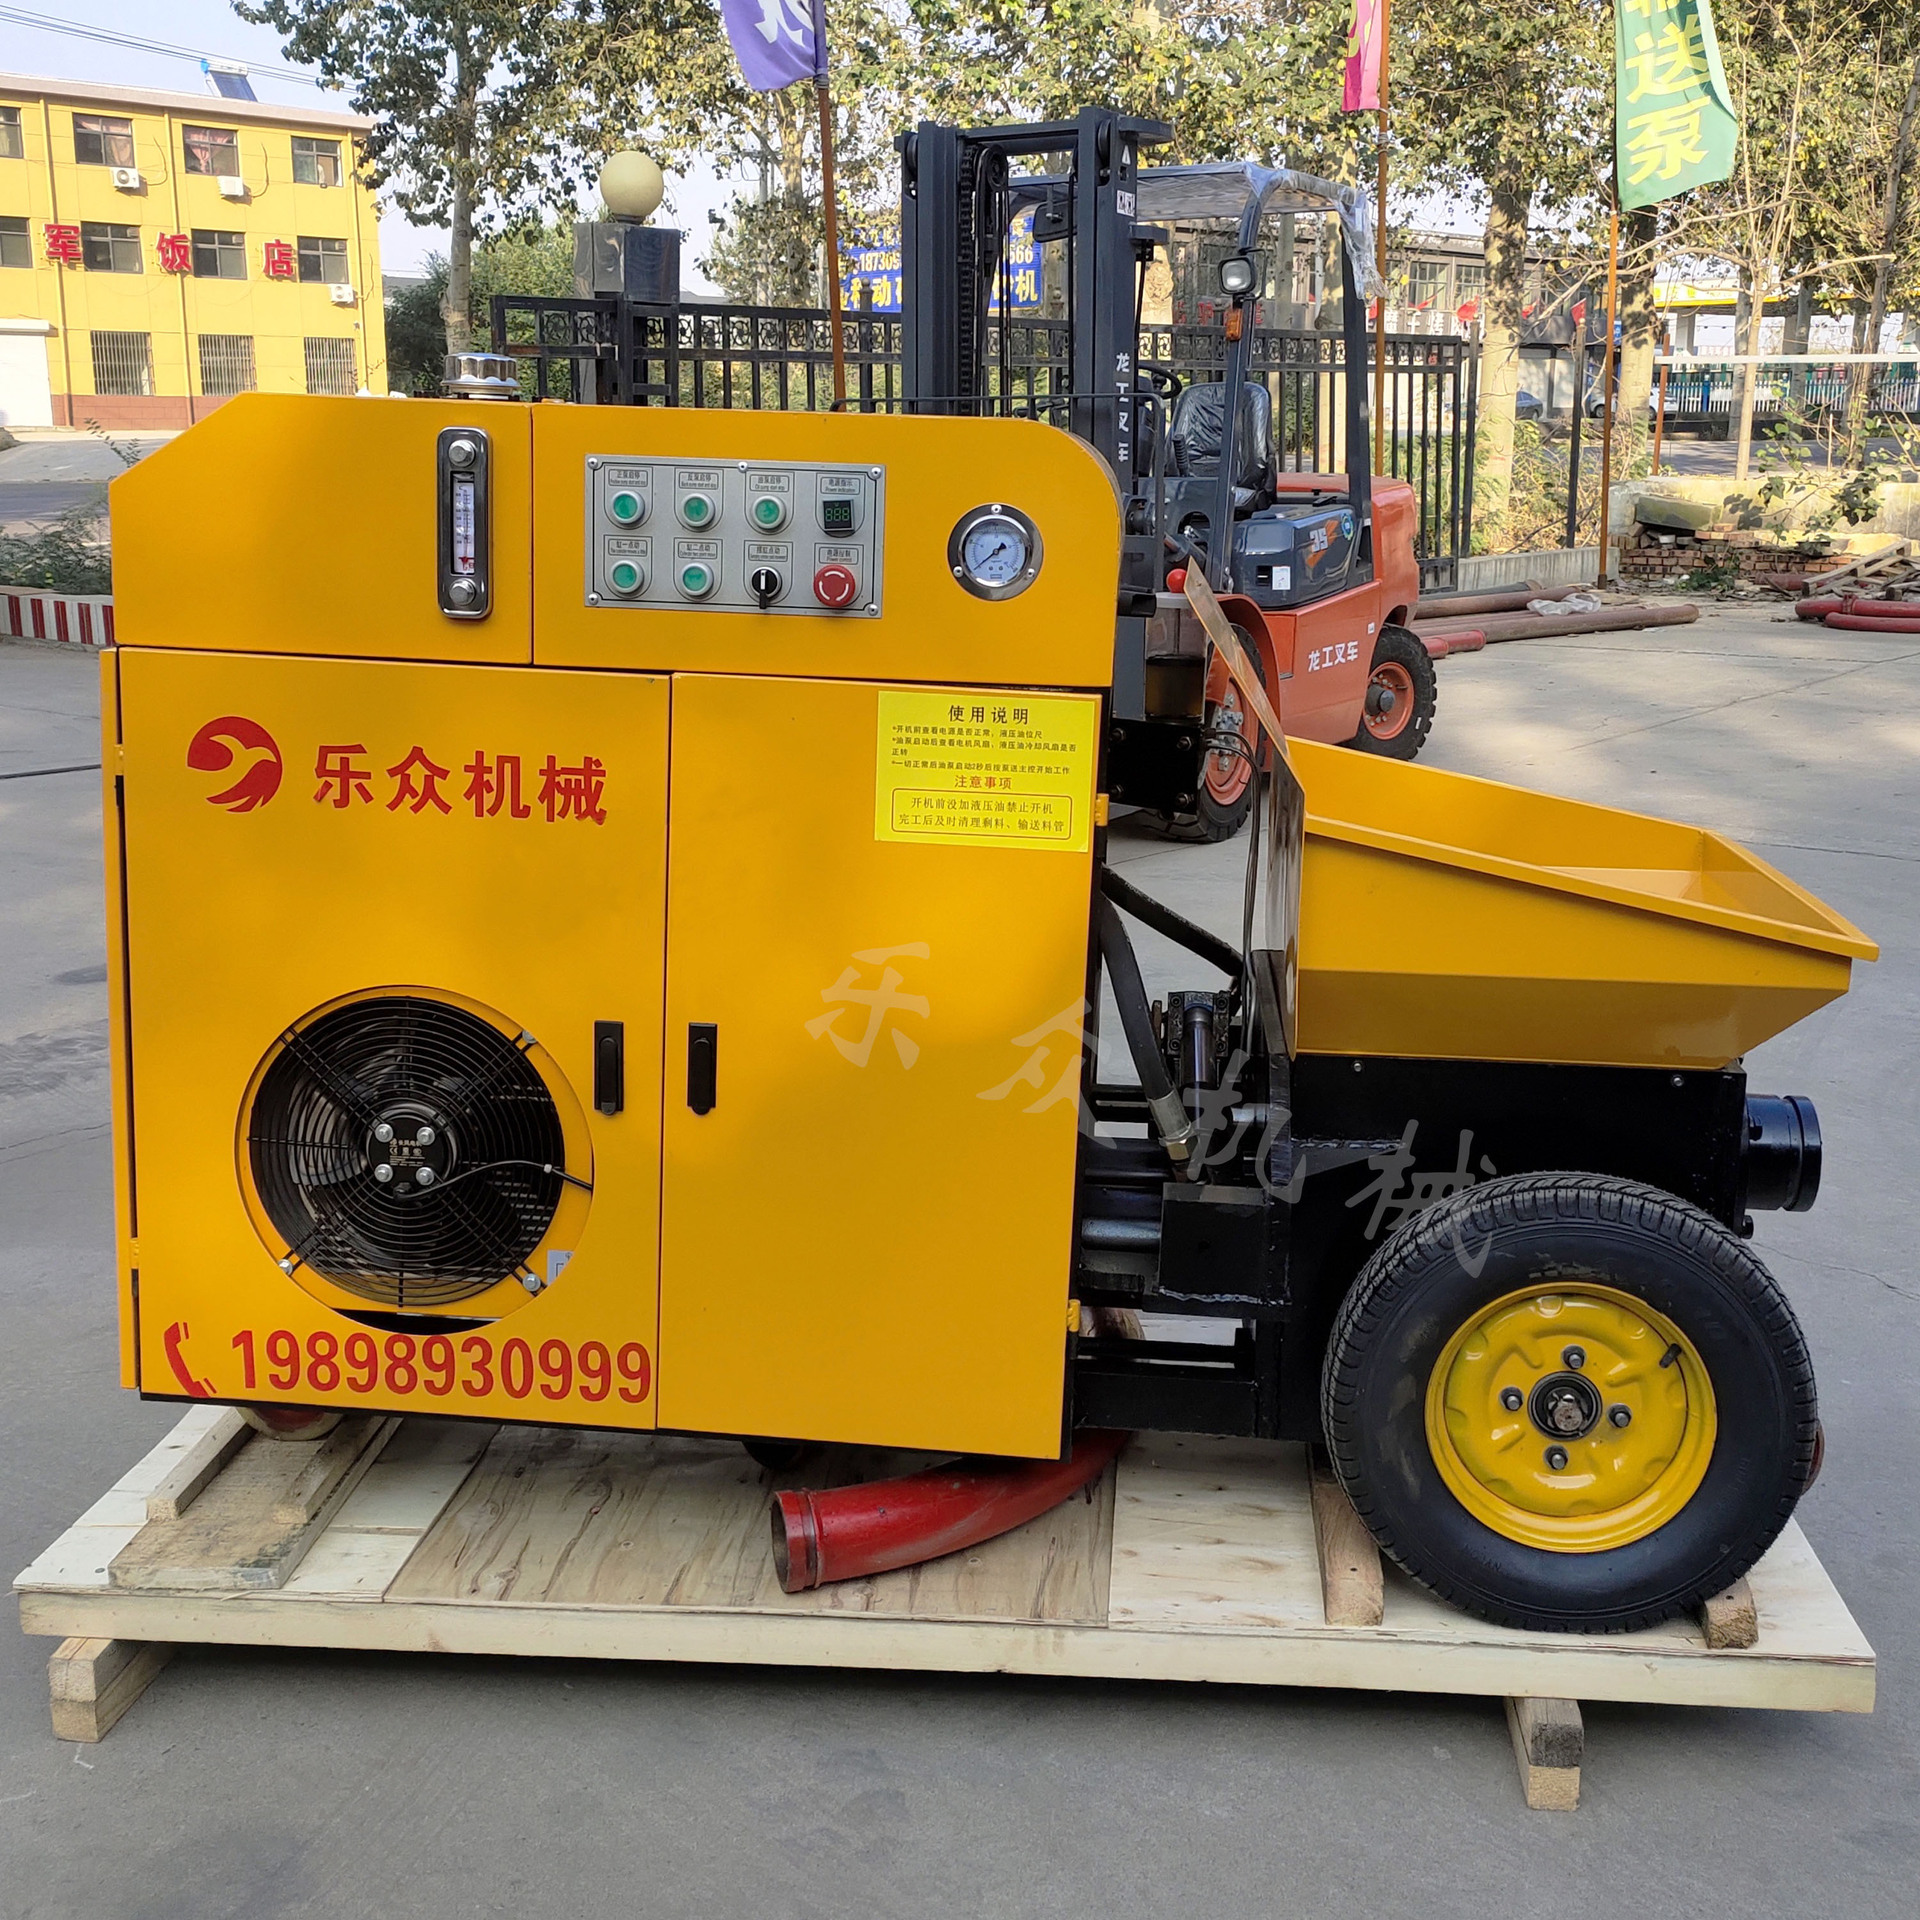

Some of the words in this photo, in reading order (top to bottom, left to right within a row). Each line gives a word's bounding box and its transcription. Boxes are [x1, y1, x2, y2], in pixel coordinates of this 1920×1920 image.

[1624, 0, 1711, 185] 送泵
[44, 223, 297, 278] 军饭店
[1116, 352, 1130, 462] 龙工叉车
[1308, 641, 1359, 673] 龙工叉车
[948, 704, 1029, 725] 使用说明
[313, 743, 608, 826] 乐众机械
[911, 796, 1053, 815] 开机前没加液压油禁止开机
[954, 774, 1012, 790] 注意事项
[231, 1329, 652, 1404] 19898930999
